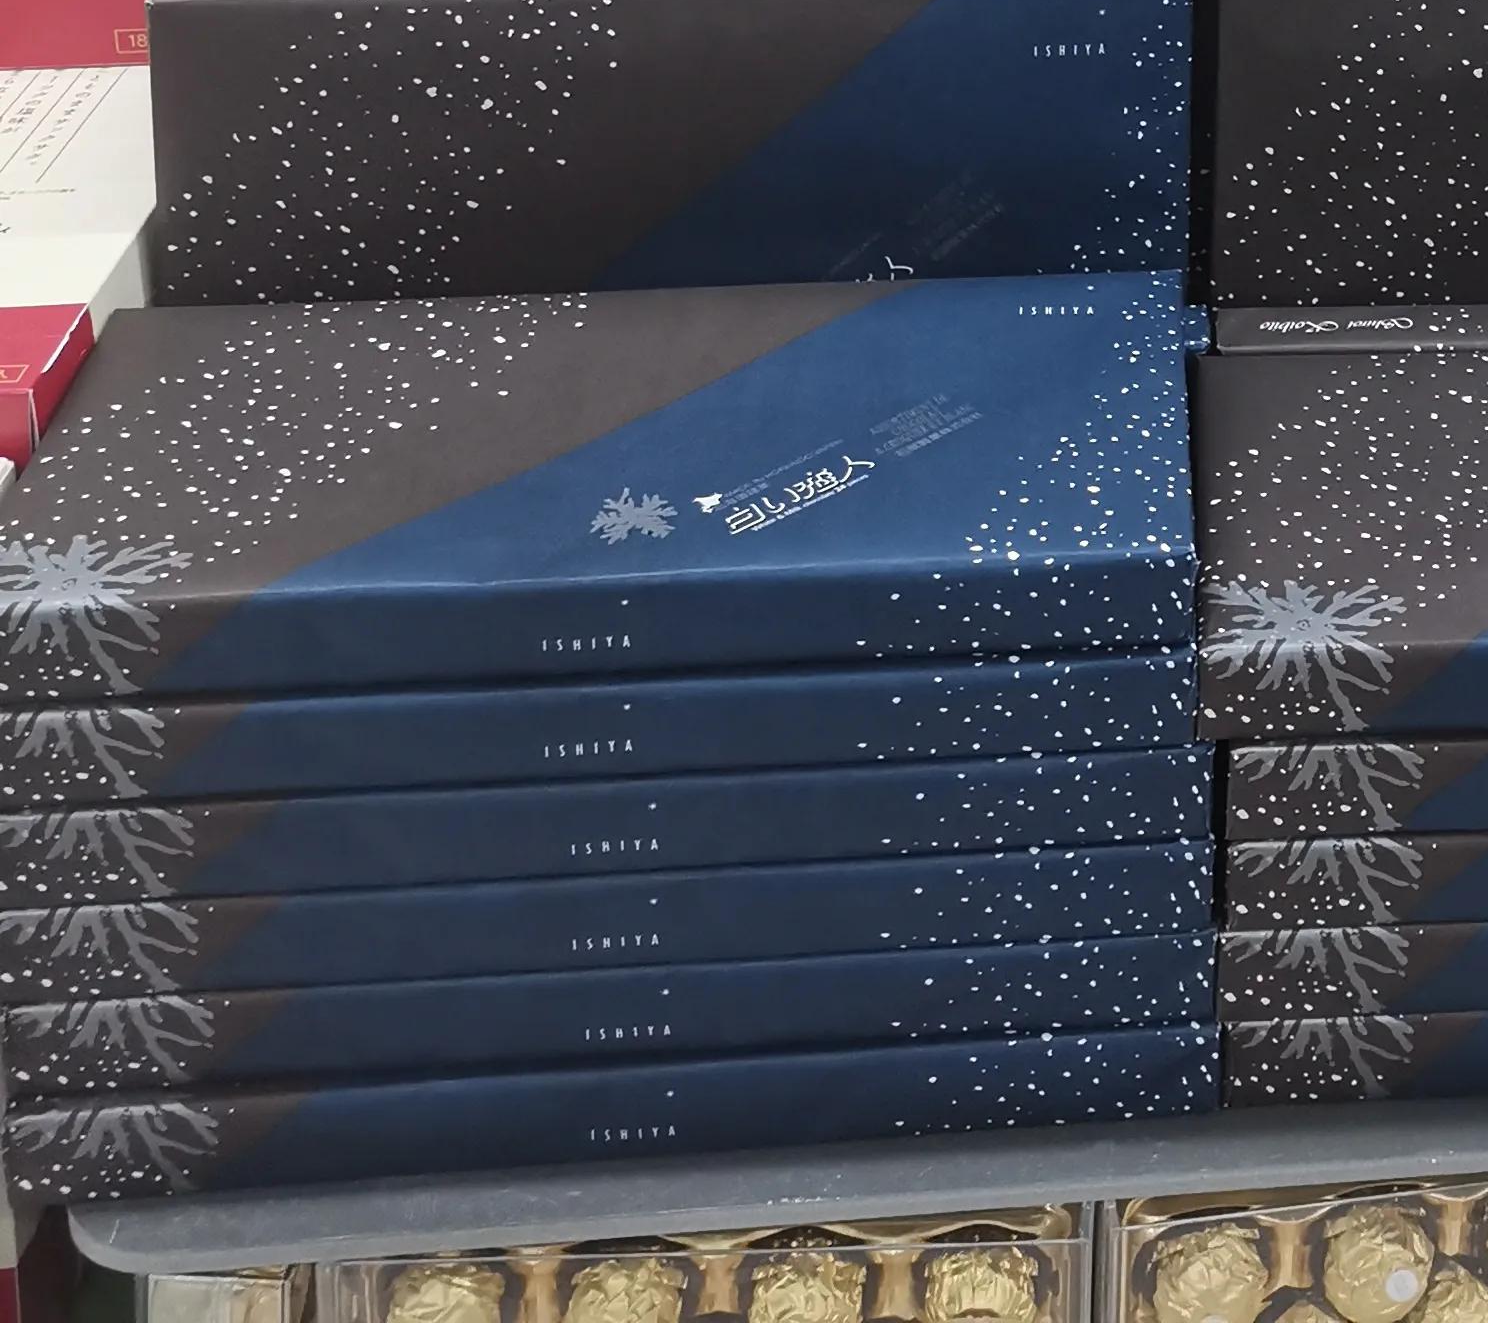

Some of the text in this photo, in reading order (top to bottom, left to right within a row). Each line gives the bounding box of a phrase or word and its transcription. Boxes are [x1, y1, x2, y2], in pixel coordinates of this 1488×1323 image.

[1033, 42, 1105, 57] ISHIYA
[1018, 306, 1096, 316] ISHIYA
[542, 634, 631, 652] ISHIYA
[545, 739, 633, 758] ISHIYA
[571, 838, 660, 856] ISHIYA
[572, 933, 659, 951] ISHIYA
[585, 1024, 671, 1041] ISHIYA
[591, 1125, 675, 1141] ISHIYA
